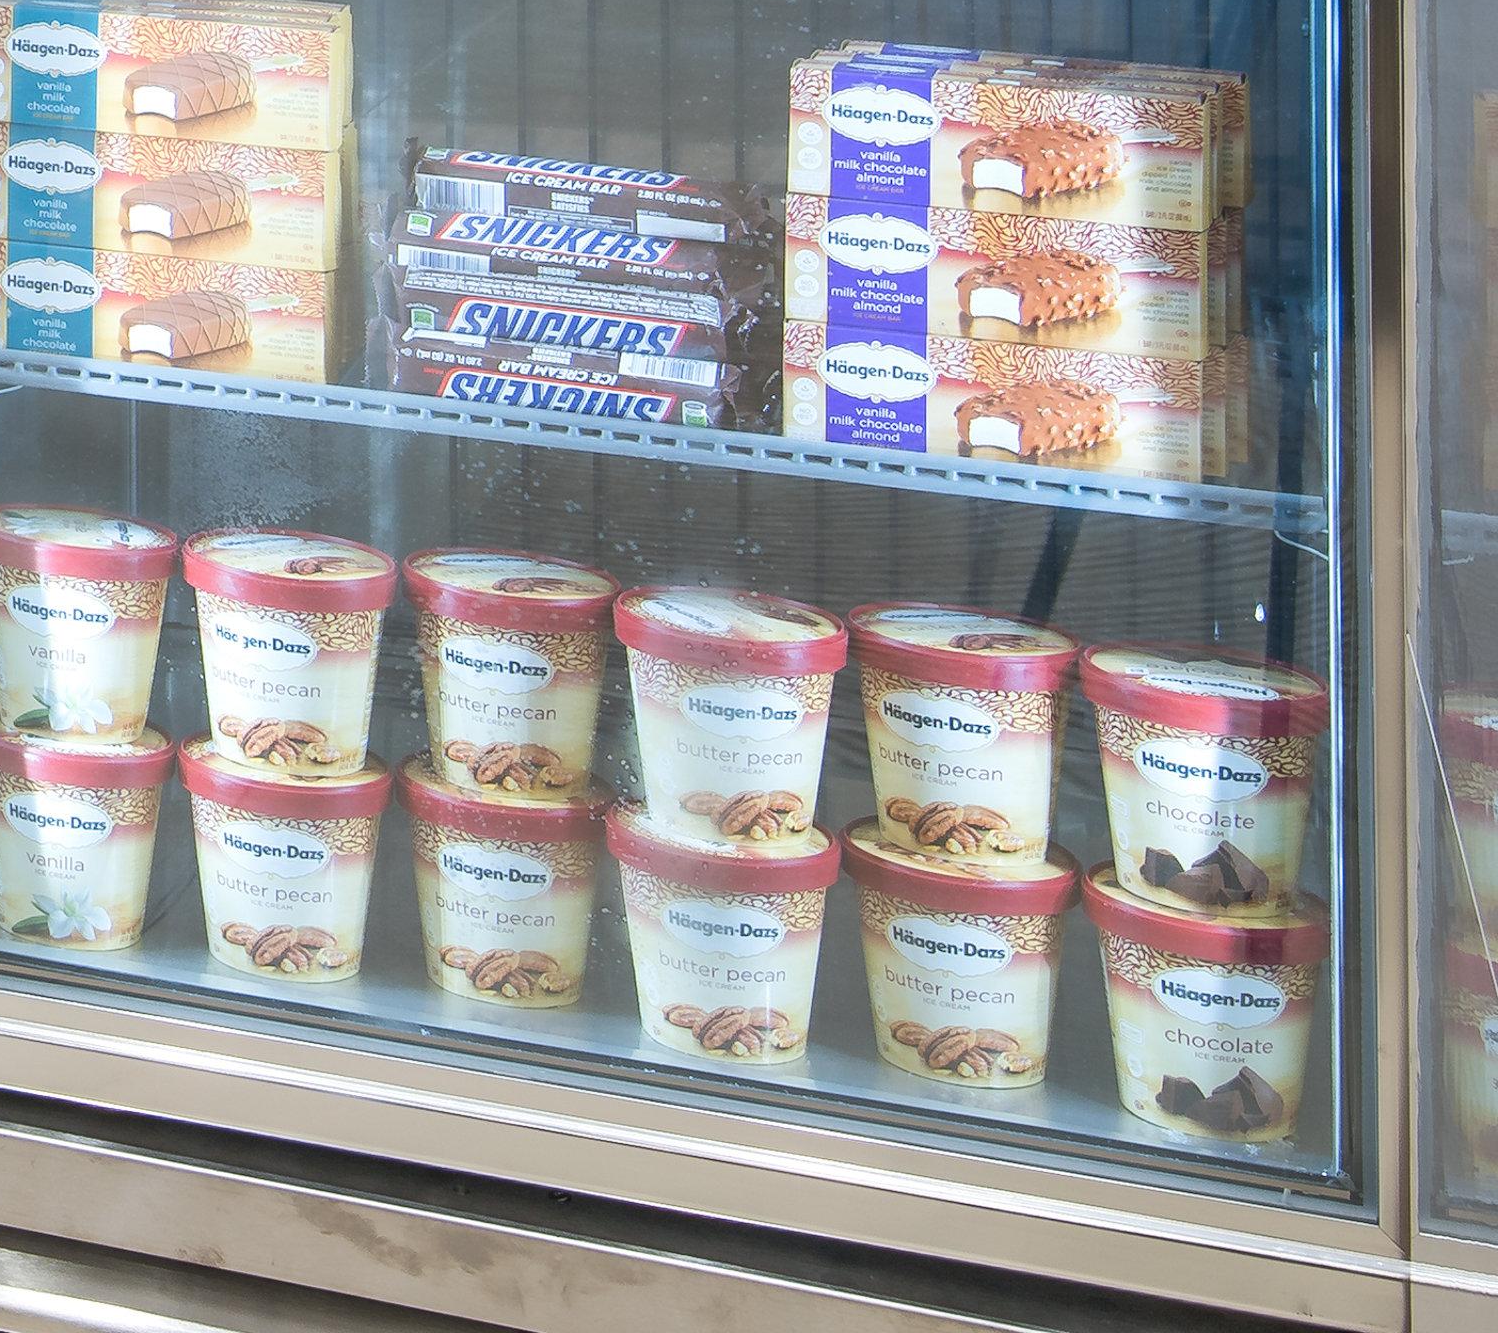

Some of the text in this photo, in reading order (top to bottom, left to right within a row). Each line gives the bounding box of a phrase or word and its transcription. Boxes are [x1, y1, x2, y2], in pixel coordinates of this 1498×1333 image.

[11, 39, 100, 63] Häagen-Dazs
[36, 80, 72, 93] vanilla
[42, 91, 66, 102] milk
[26, 100, 81, 115] chocolate
[830, 103, 935, 129] Häagen-Dazs
[833, 157, 928, 179] milk chocolate
[857, 148, 902, 165] vanilla
[535, 175, 591, 193] CREAM
[592, 182, 623, 197] BAR
[855, 172, 905, 188] almond
[454, 214, 676, 267] SNICKERS
[11, 596, 110, 626] Häagen-Dazs
[27, 641, 87, 666] vanilla
[687, 695, 799, 724] Häagen-Dazs
[676, 737, 803, 769] butter pecan
[1141, 751, 1263, 785] Häagen-Dazs
[1144, 797, 1256, 831] chocolate
[223, 833, 326, 864] Häagen-Dazs
[216, 872, 334, 907] butter pecan
